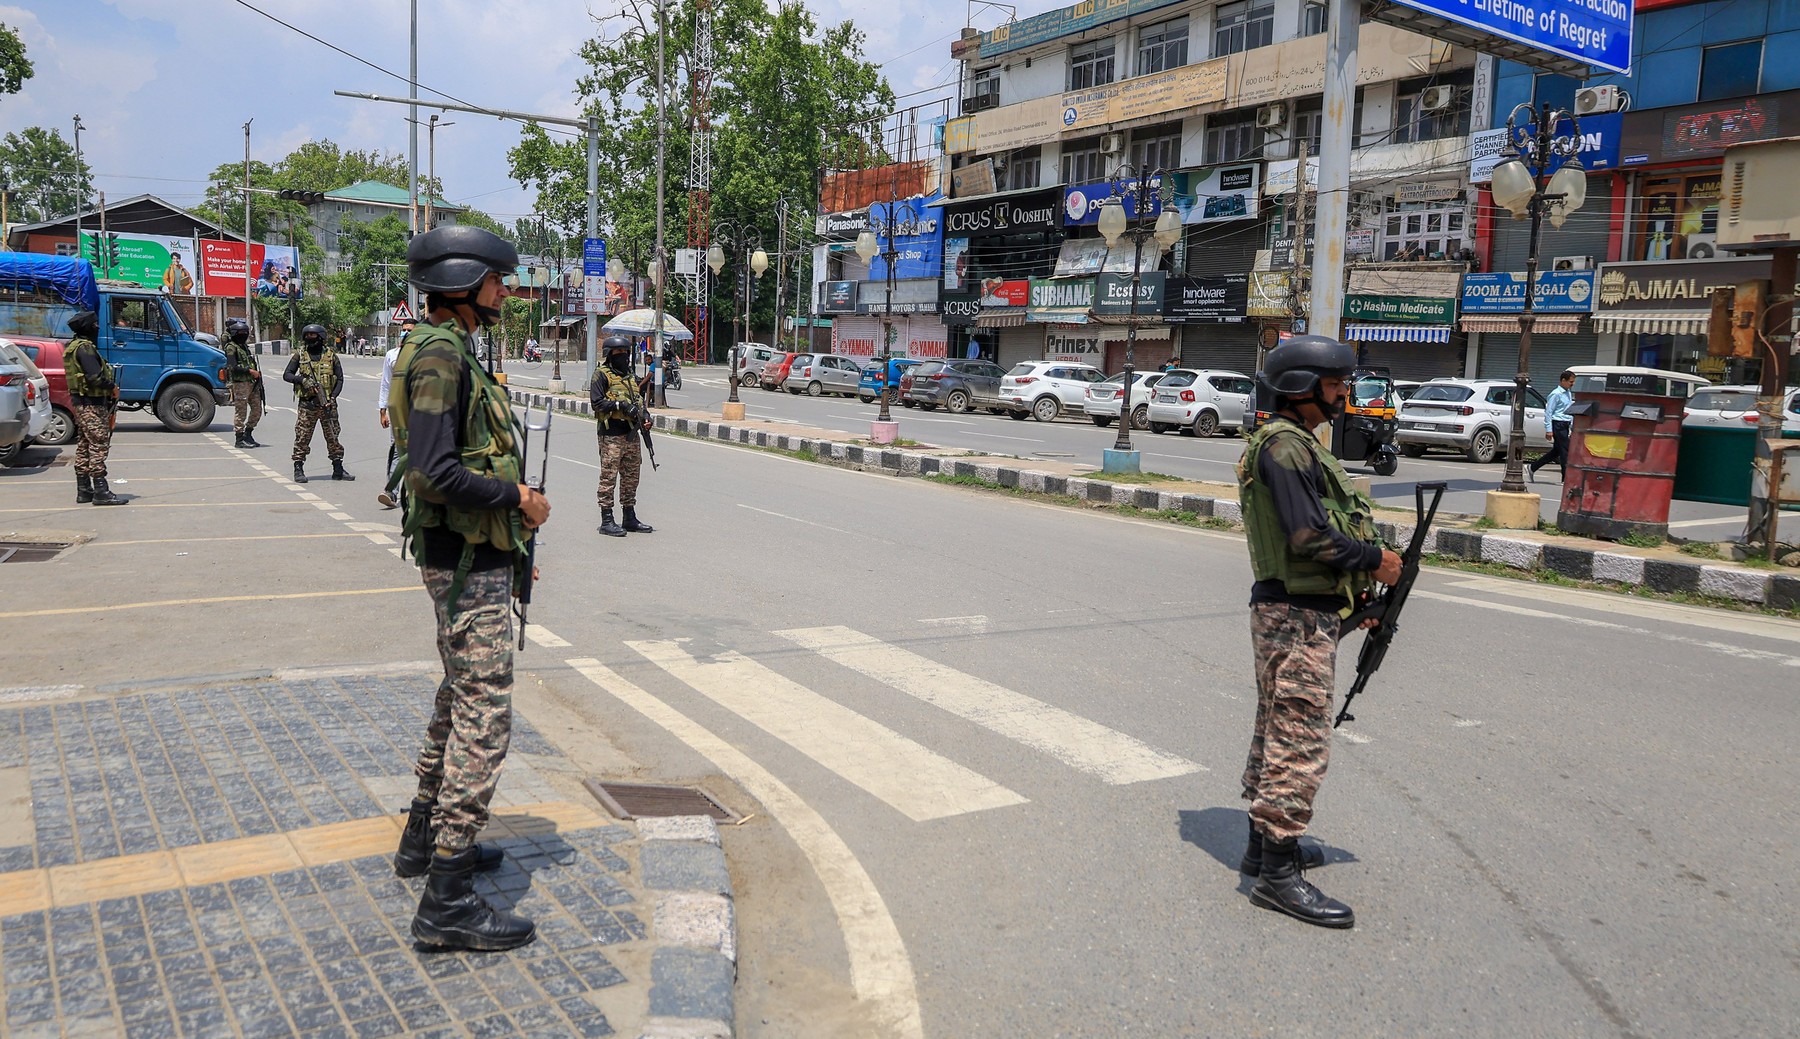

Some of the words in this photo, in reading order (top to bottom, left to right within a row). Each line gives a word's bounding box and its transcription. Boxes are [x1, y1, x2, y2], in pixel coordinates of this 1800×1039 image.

[1076, 0, 1093, 16] LIC
[994, 27, 1007, 41] LIC
[1540, 10, 1556, 32] of
[1560, 13, 1607, 50] Regret
[1475, 58, 1490, 127] Canon
[1474, 132, 1508, 144] CERTIFIED
[1223, 173, 1250, 182] hindware
[1692, 182, 1722, 193] AJMA
[828, 218, 866, 231] Panasonic
[1276, 240, 1295, 248] DENTA
[905, 250, 921, 260] Shop
[1032, 284, 1091, 306] SUBHANA
[1183, 286, 1226, 298] hindware
[1465, 285, 1500, 297] ZOOM
[1503, 284, 1521, 296] AT
[1524, 283, 1568, 296] EGAL
[1625, 279, 1702, 300] AJMAL
[891, 303, 915, 312] MOTORS
[919, 303, 936, 312] YAMAHA
[944, 299, 980, 315] ICRUS
[1363, 301, 1397, 312] Hashim
[1400, 302, 1445, 314] Medicate
[847, 339, 874, 356] YAMAHA
[920, 340, 948, 358] YAMAHA
[1046, 335, 1100, 354] Prinex
[1618, 376, 1643, 384] 190001
